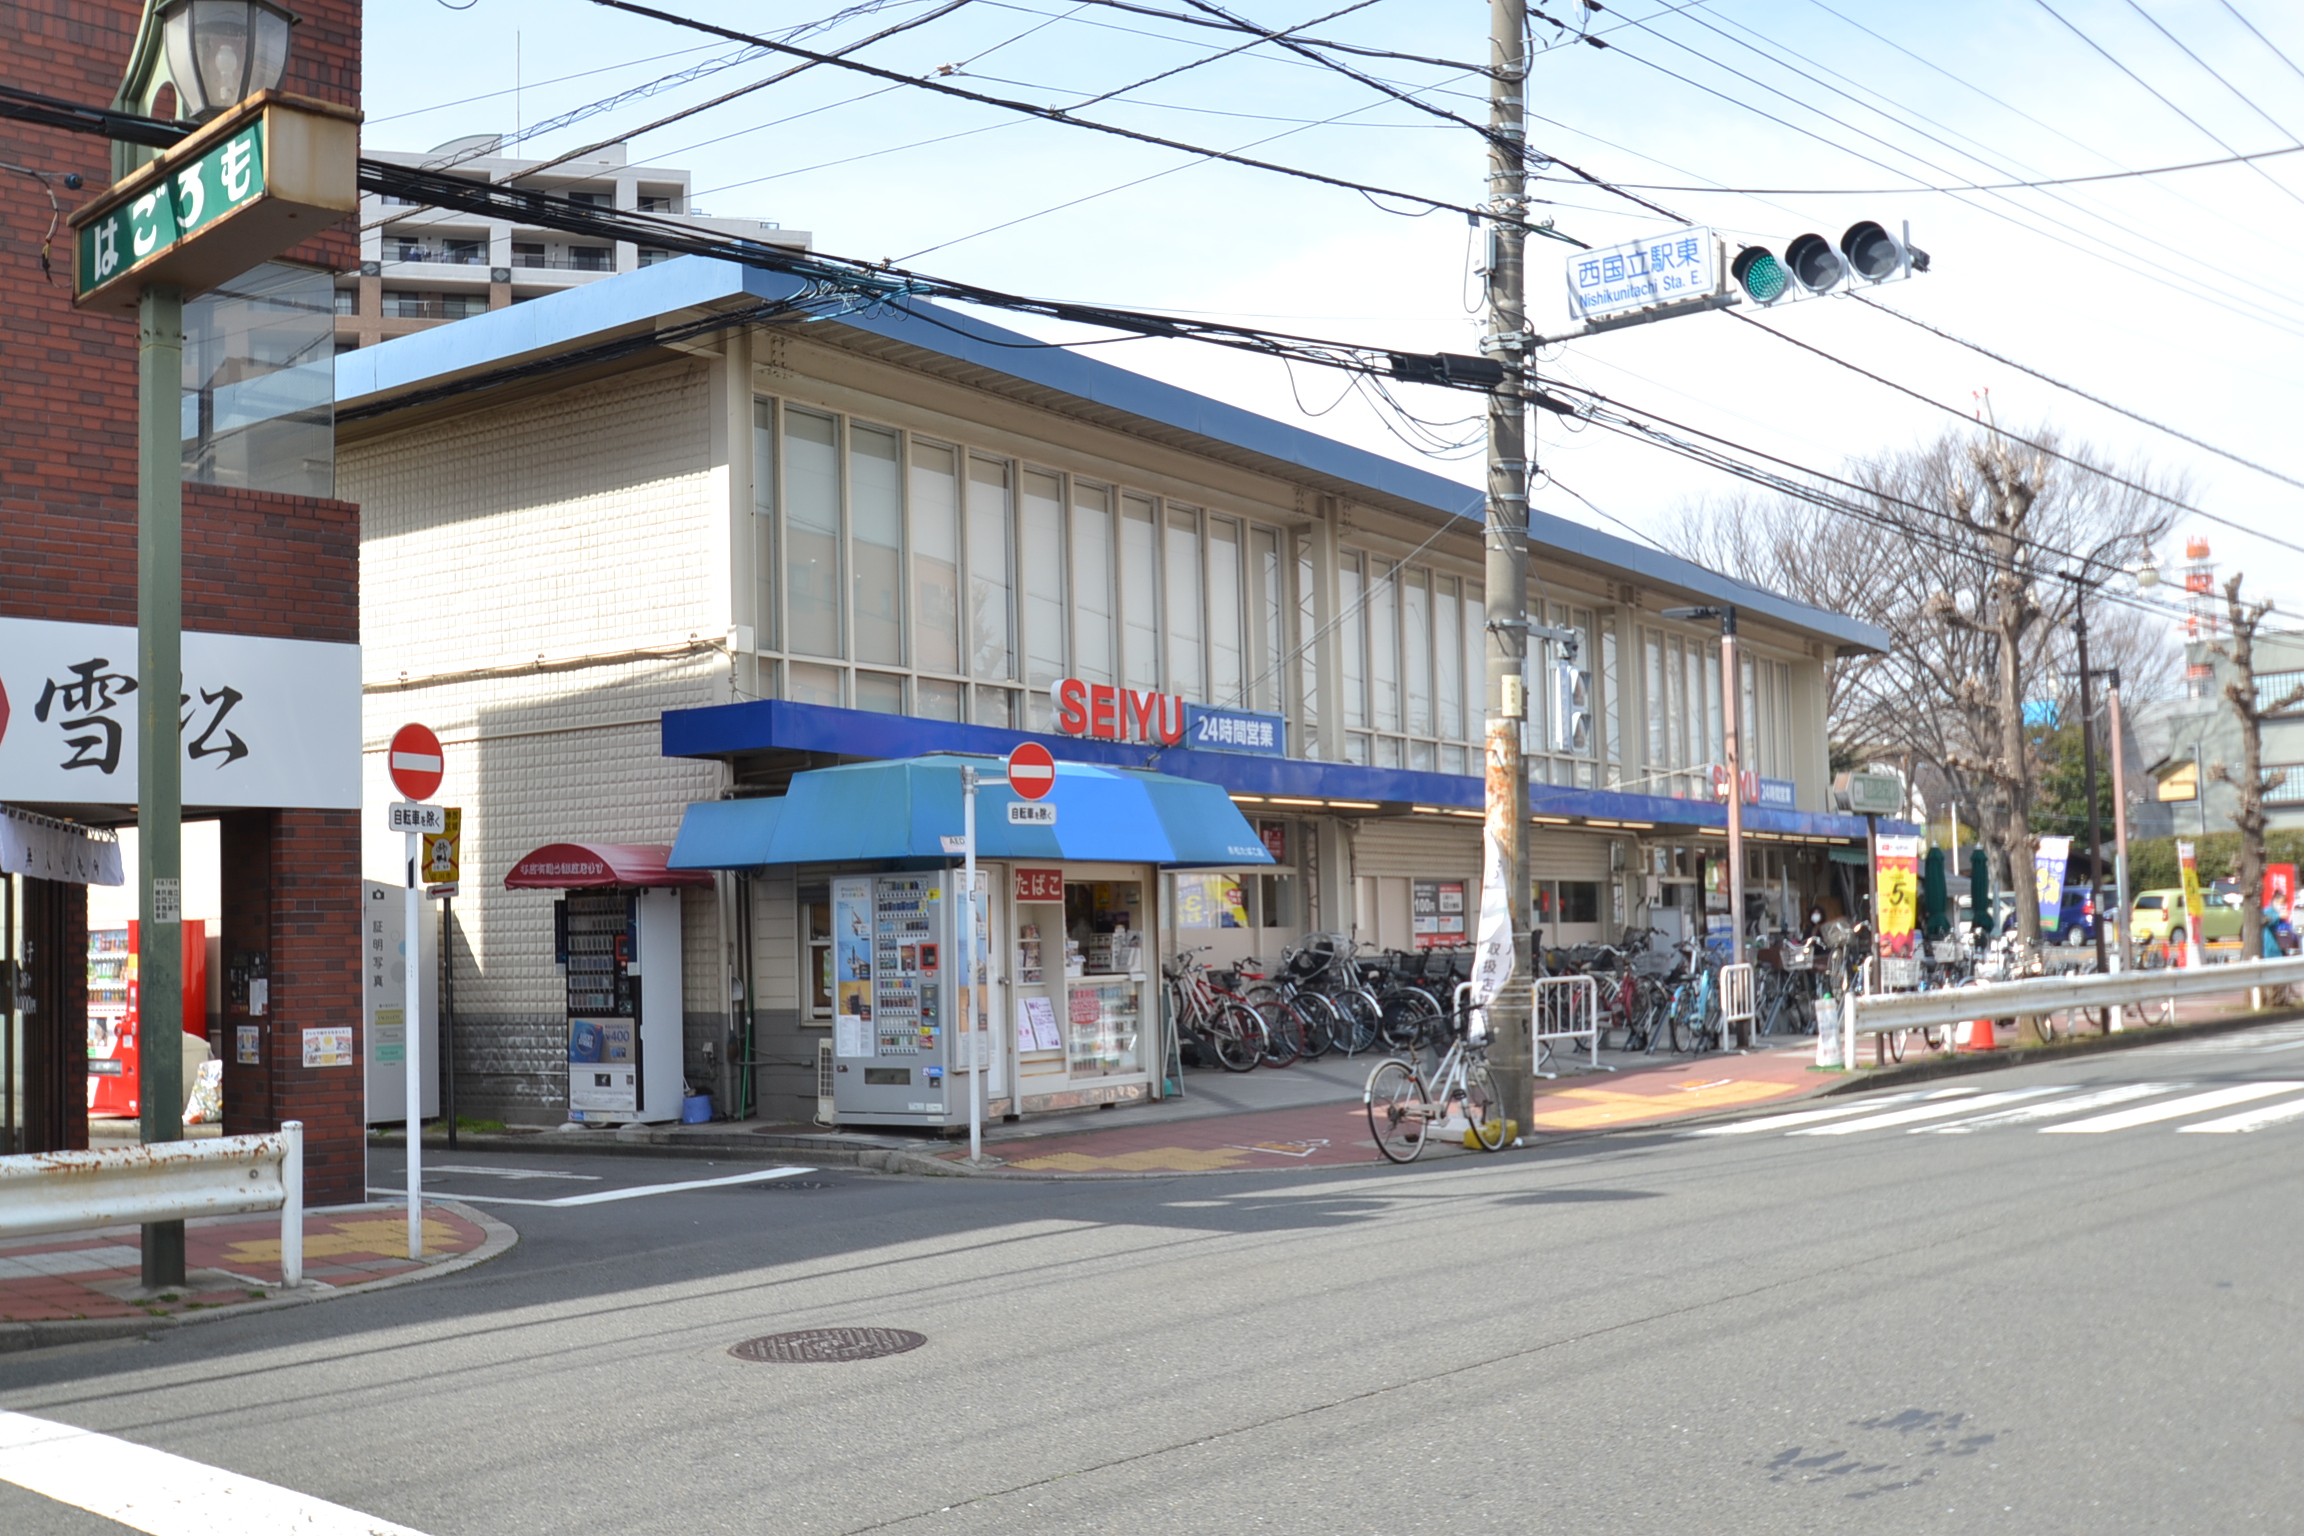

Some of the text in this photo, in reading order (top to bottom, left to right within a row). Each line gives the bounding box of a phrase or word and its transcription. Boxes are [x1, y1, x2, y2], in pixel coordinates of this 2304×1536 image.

[94, 138, 252, 281] はごろも
[1578, 237, 1700, 288] 西国立駅東
[1579, 270, 1702, 309] Nishikunitachi Sta. E.
[34, 657, 249, 774] 雪松
[1052, 678, 1183, 746] SEIYU
[1198, 716, 1274, 748] 24時間営業
[1709, 764, 1759, 804] SYU
[394, 809, 440, 828] 自転車を除く
[1011, 807, 1052, 820] 自転車を除く
[949, 837, 965, 845] AED
[1015, 873, 1060, 896] たばこ
[372, 920, 384, 988] 証明写真
